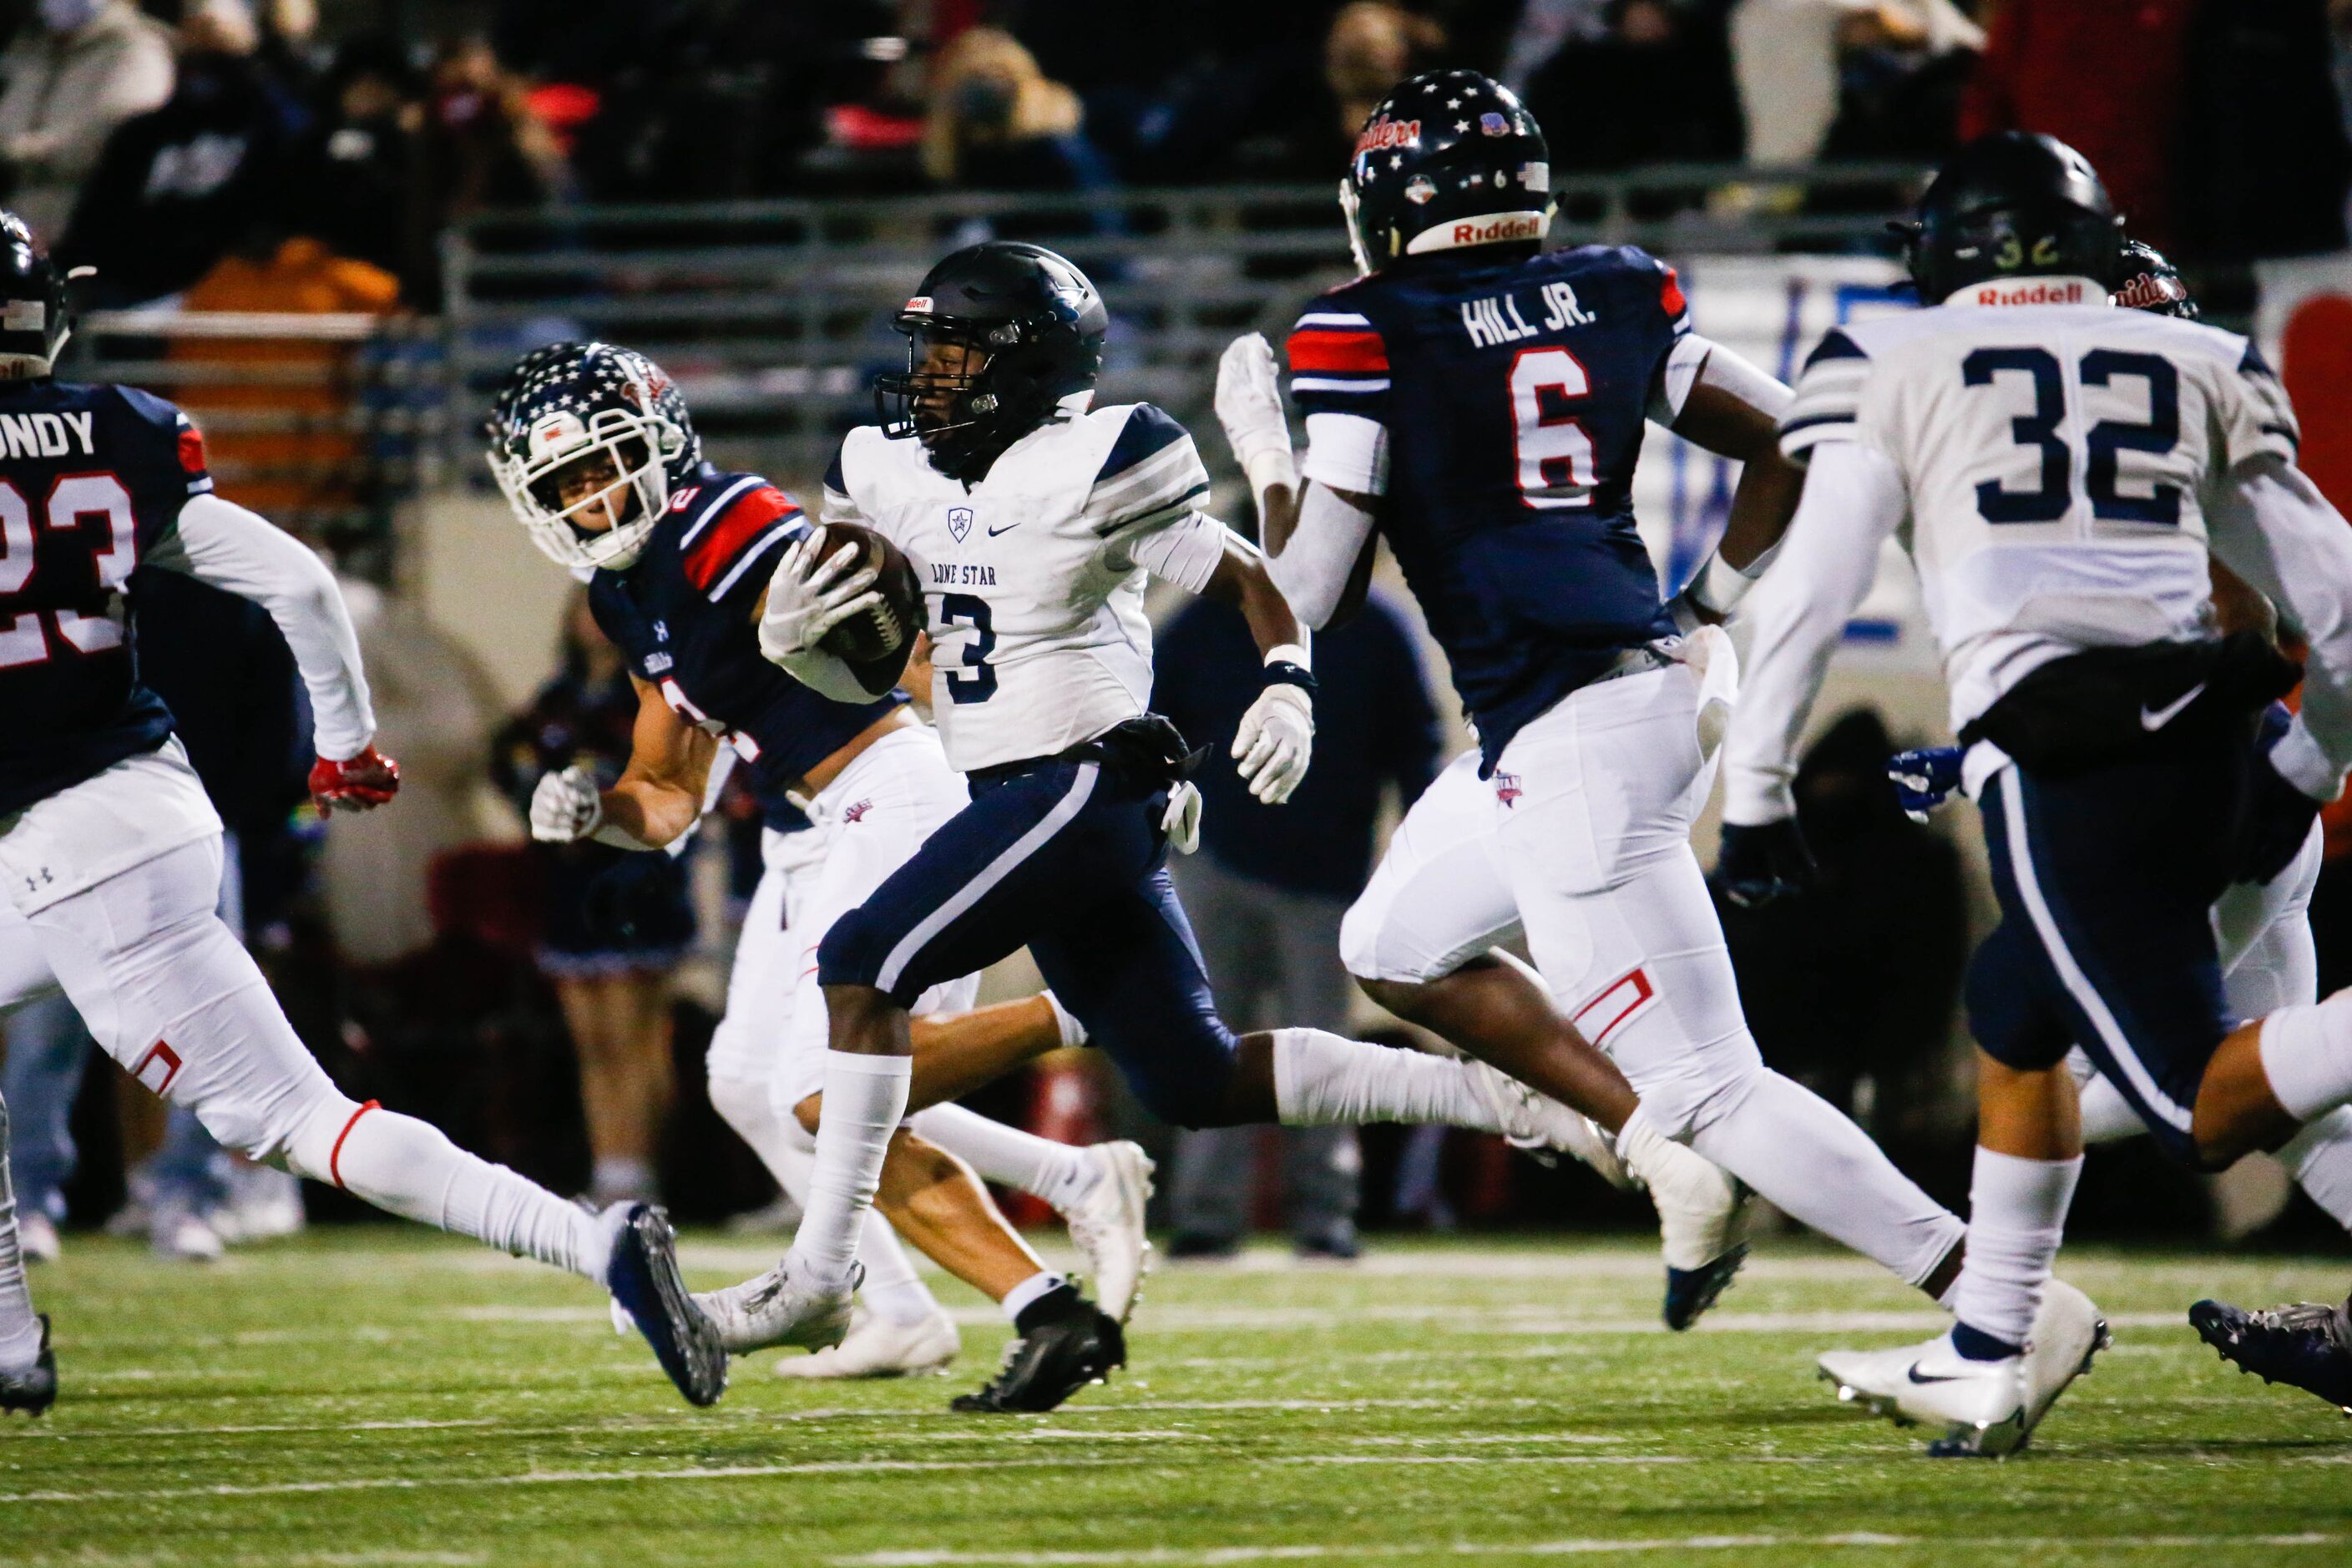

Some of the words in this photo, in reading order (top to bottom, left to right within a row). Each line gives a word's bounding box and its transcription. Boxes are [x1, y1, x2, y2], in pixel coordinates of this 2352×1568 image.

[1494, 169, 1507, 189] 6
[1453, 217, 1540, 245] Riddell
[1461, 292, 1539, 349] HILL
[1540, 281, 1596, 331] JR.
[1977, 281, 2084, 306] Riddell
[0, 411, 94, 459] NDY
[1505, 345, 1600, 510] 6
[1961, 345, 2182, 525] 32
[931, 563, 958, 584] LONE
[961, 565, 997, 586] STAR
[940, 592, 999, 705] 3
